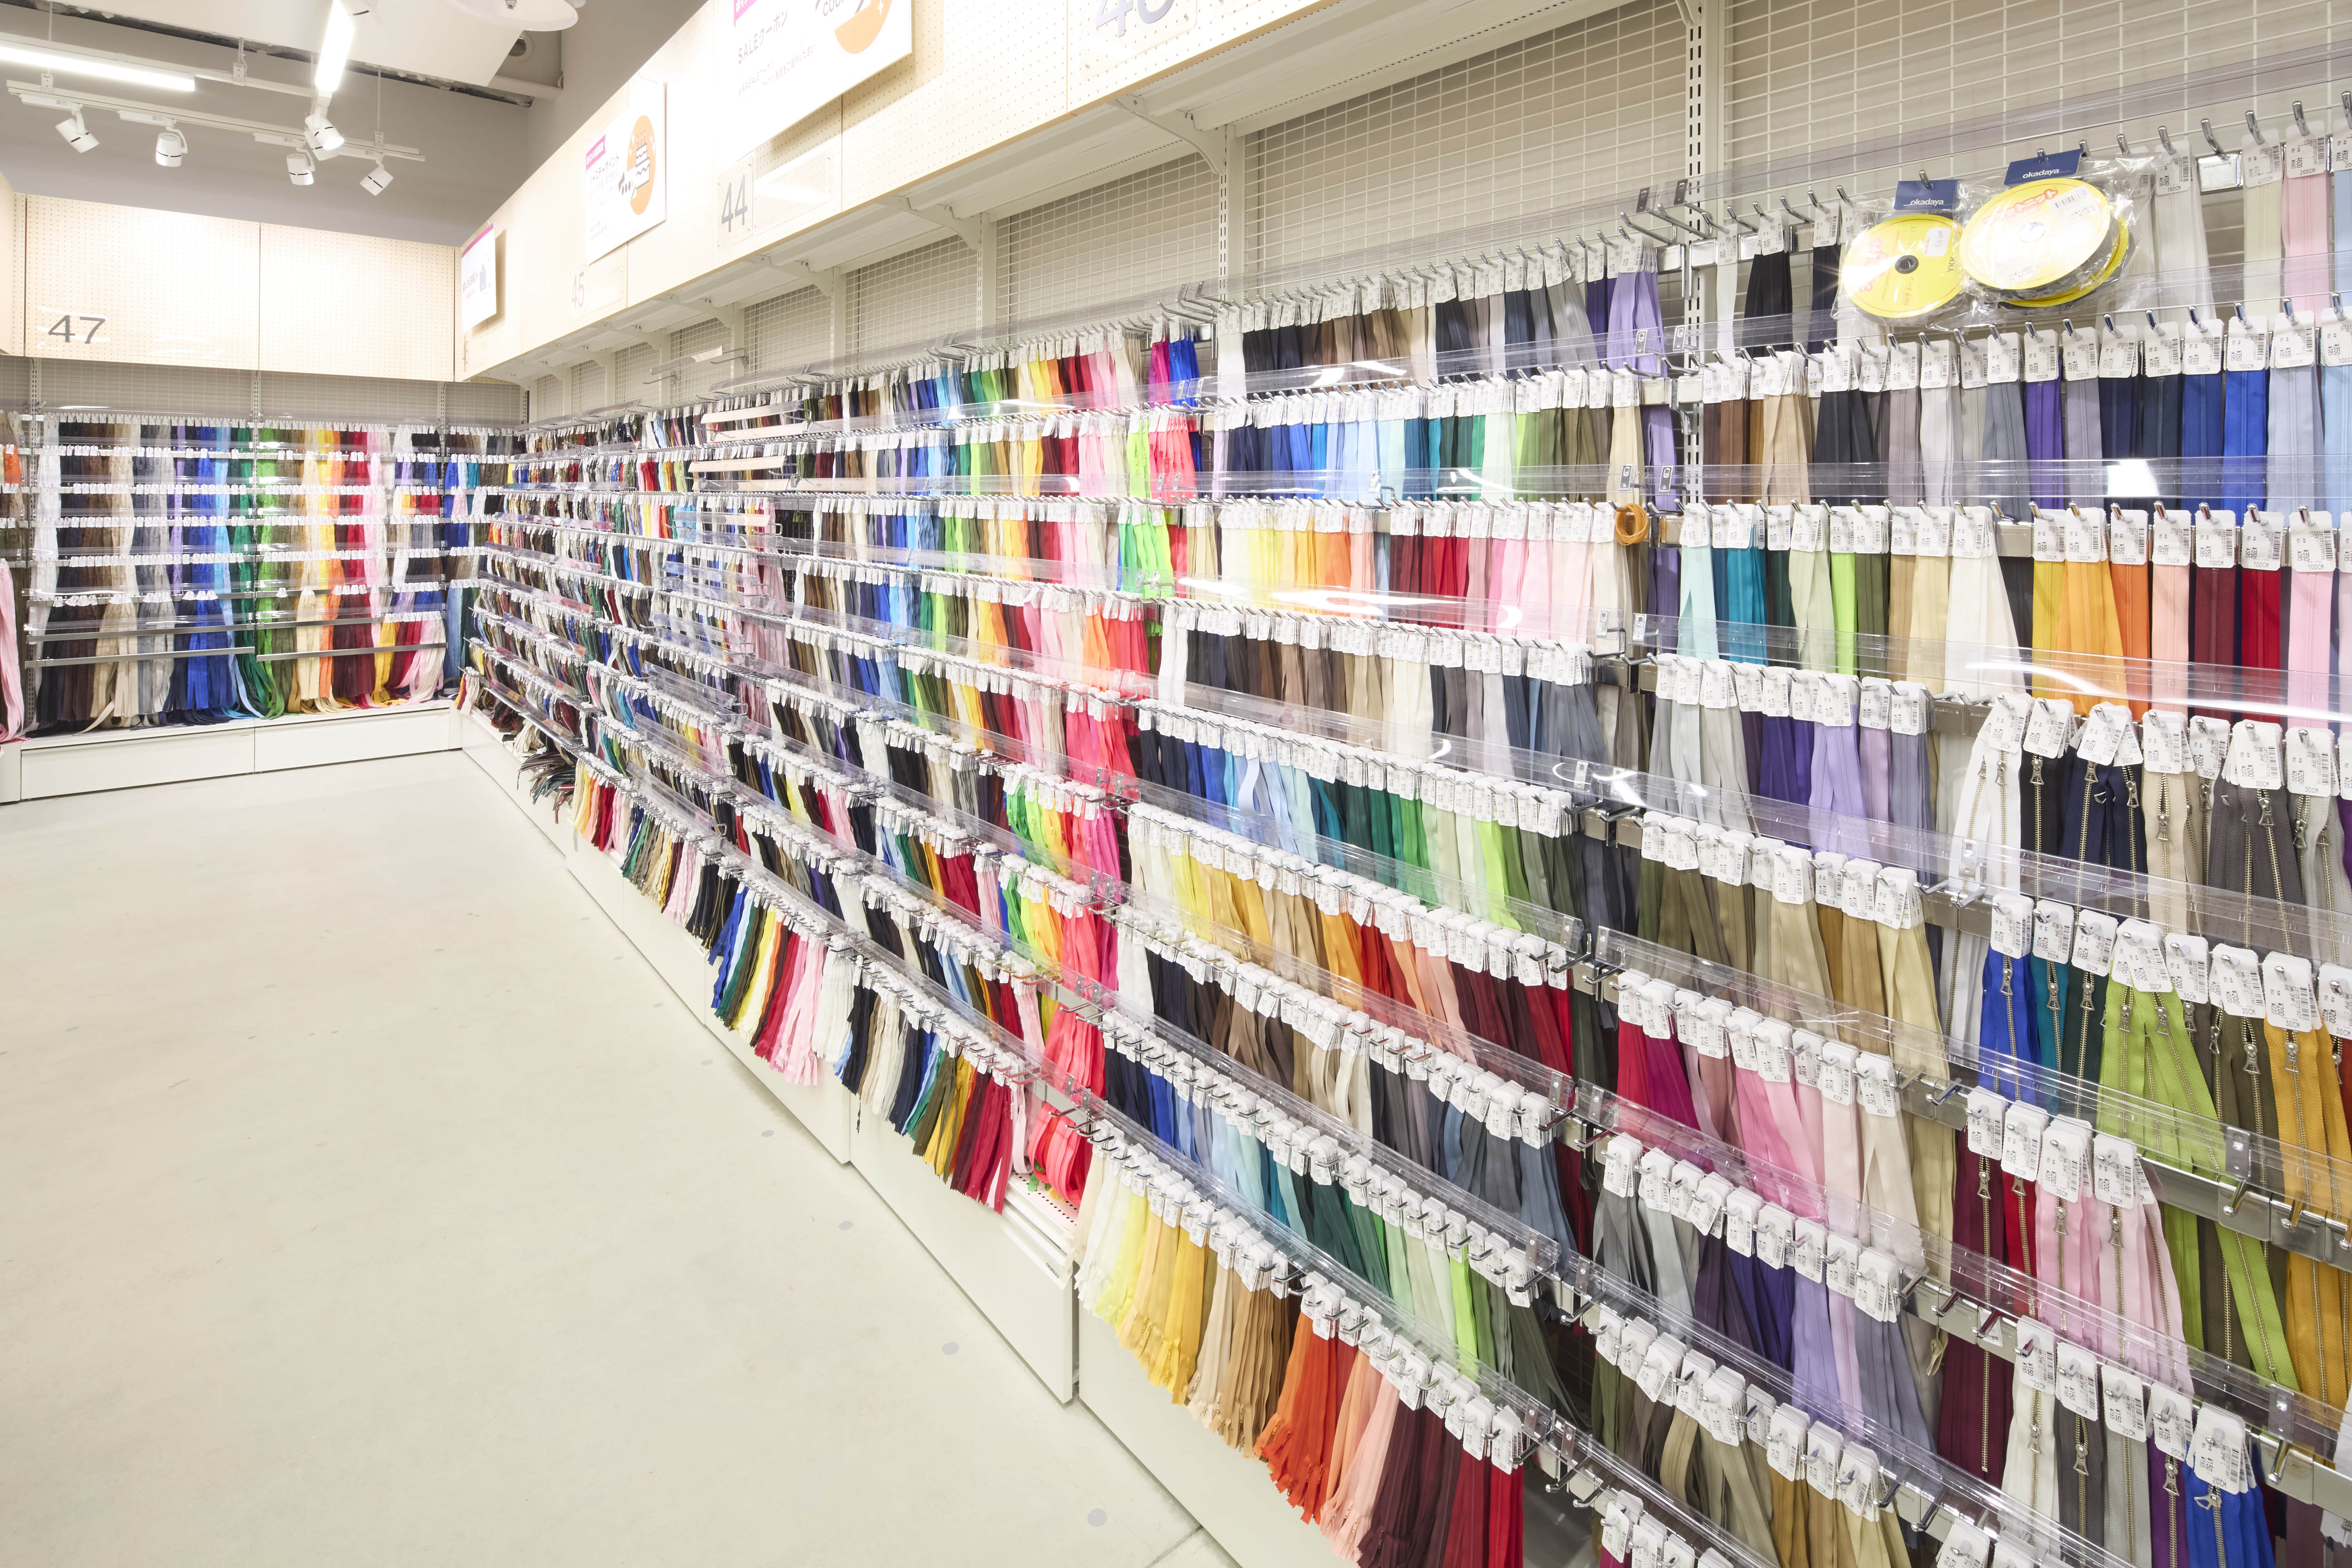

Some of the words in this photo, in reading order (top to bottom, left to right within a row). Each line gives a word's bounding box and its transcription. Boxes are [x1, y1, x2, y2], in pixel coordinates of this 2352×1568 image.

[738, 10, 788, 65] SALEクーポン
[2022, 167, 2060, 179] okadaya
[720, 174, 748, 232] 44
[571, 271, 585, 310] 45
[48, 314, 106, 344] 47
[2088, 739, 2096, 752] ¥200
[2203, 770, 2215, 778] 30CM
[2002, 946, 2013, 955] 30CM
[2086, 963, 2098, 972] 30CM
[2139, 967, 2147, 980] ¥200
[2183, 992, 2196, 1000] 30CM
[2232, 990, 2240, 1004] ¥200
[2241, 1007, 2256, 1016] 30CM
[2276, 1003, 2285, 1017] ¥200
[2285, 1020, 2301, 1029] 30CM
[2335, 1027, 2351, 1036] 30CM
[1981, 1147, 1993, 1156] 30CM
[2014, 1167, 2027, 1177] 30CM
[2056, 1188, 2069, 1198] 30CM
[2109, 1195, 2123, 1205] 30CM
[2034, 1381, 2046, 1390] 20CM
[2076, 1405, 2088, 1416] 20CM
[2123, 1427, 2136, 1438] 20CM
[2171, 1448, 2185, 1460] 20CM
[2212, 1477, 2227, 1489] 20CM
